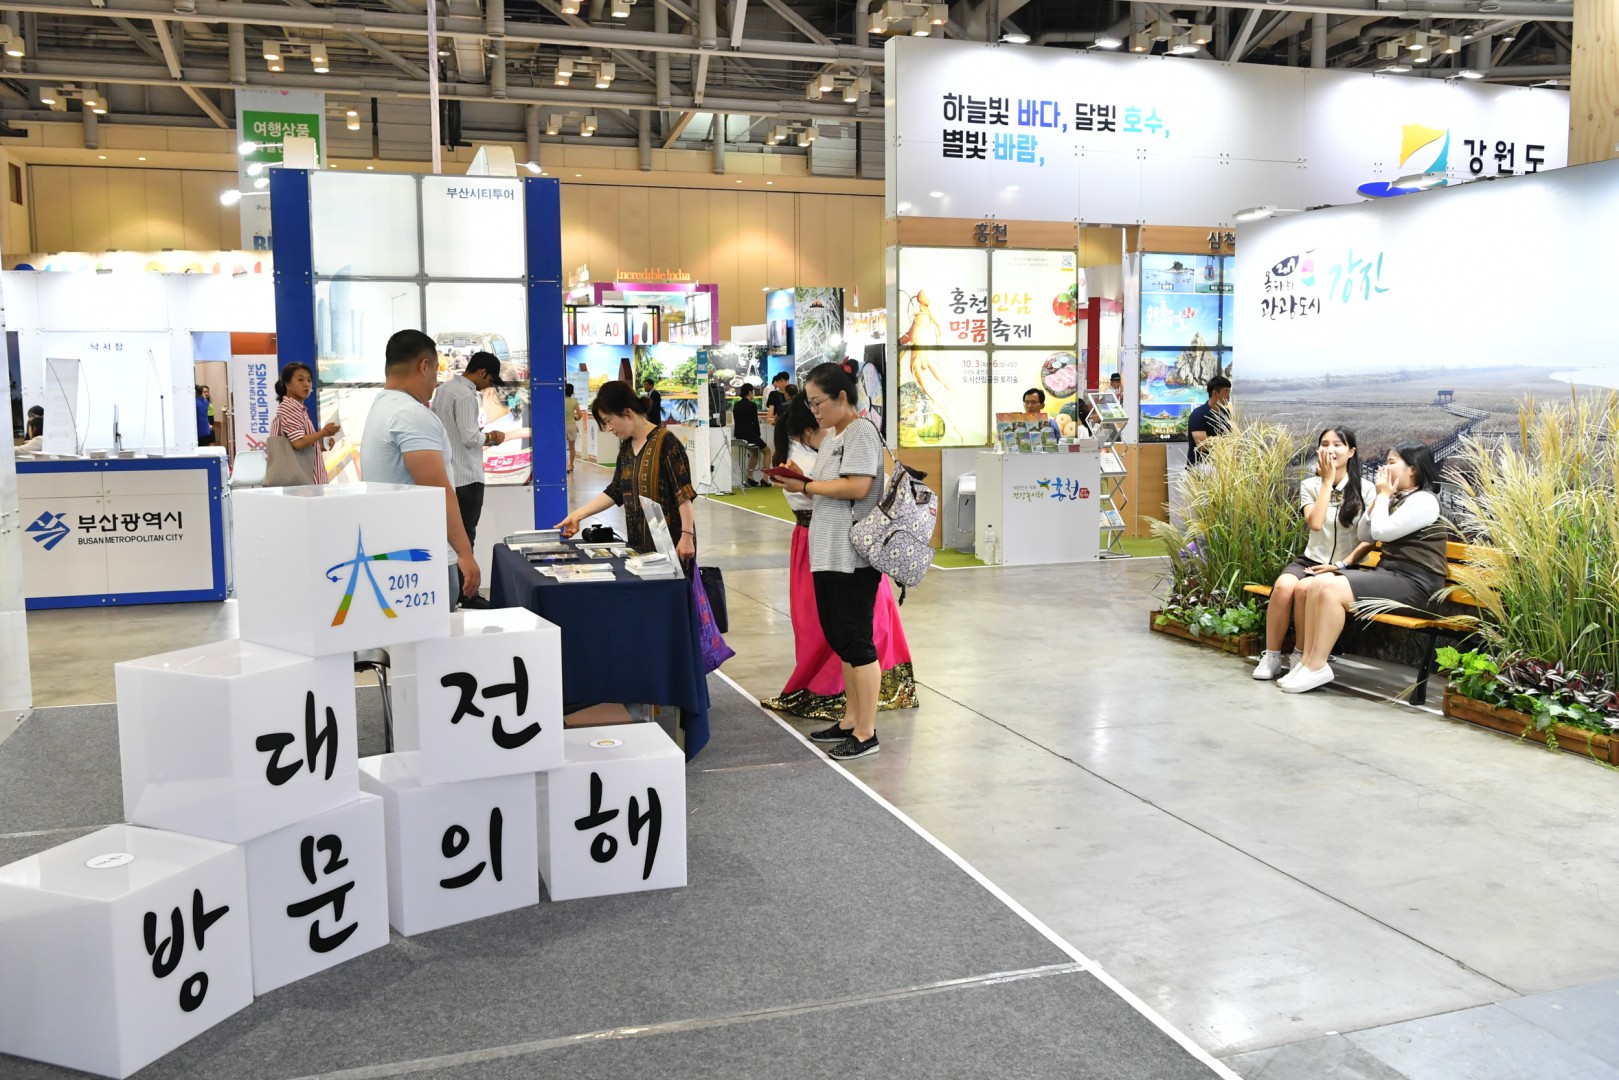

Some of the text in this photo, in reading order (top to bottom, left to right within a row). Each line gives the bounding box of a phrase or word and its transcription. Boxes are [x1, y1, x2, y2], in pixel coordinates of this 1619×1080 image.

[943, 92, 1170, 139] 하늘빛 바다, 달빛 호수,
[253, 121, 310, 138] 여행상품
[943, 129, 1045, 167] 별빛 바람,
[1463, 139, 1546, 175] 강원도
[446, 187, 515, 201] 부산시티투어
[974, 223, 1008, 243] 홍천
[616, 268, 666, 280] Incredible
[1327, 247, 1390, 304] 강진
[1261, 294, 1321, 321] 관광도시
[248, 377, 255, 386] IN
[256, 363, 270, 434] PHILIPPINES
[250, 402, 258, 421] MORE
[1050, 477, 1079, 502] 홍천
[78, 511, 183, 533] 부산광역시
[78, 537, 104, 545] BUSAN
[105, 535, 164, 544] METROPOLITAN
[388, 573, 419, 590] 2019
[574, 772, 662, 880] 해
